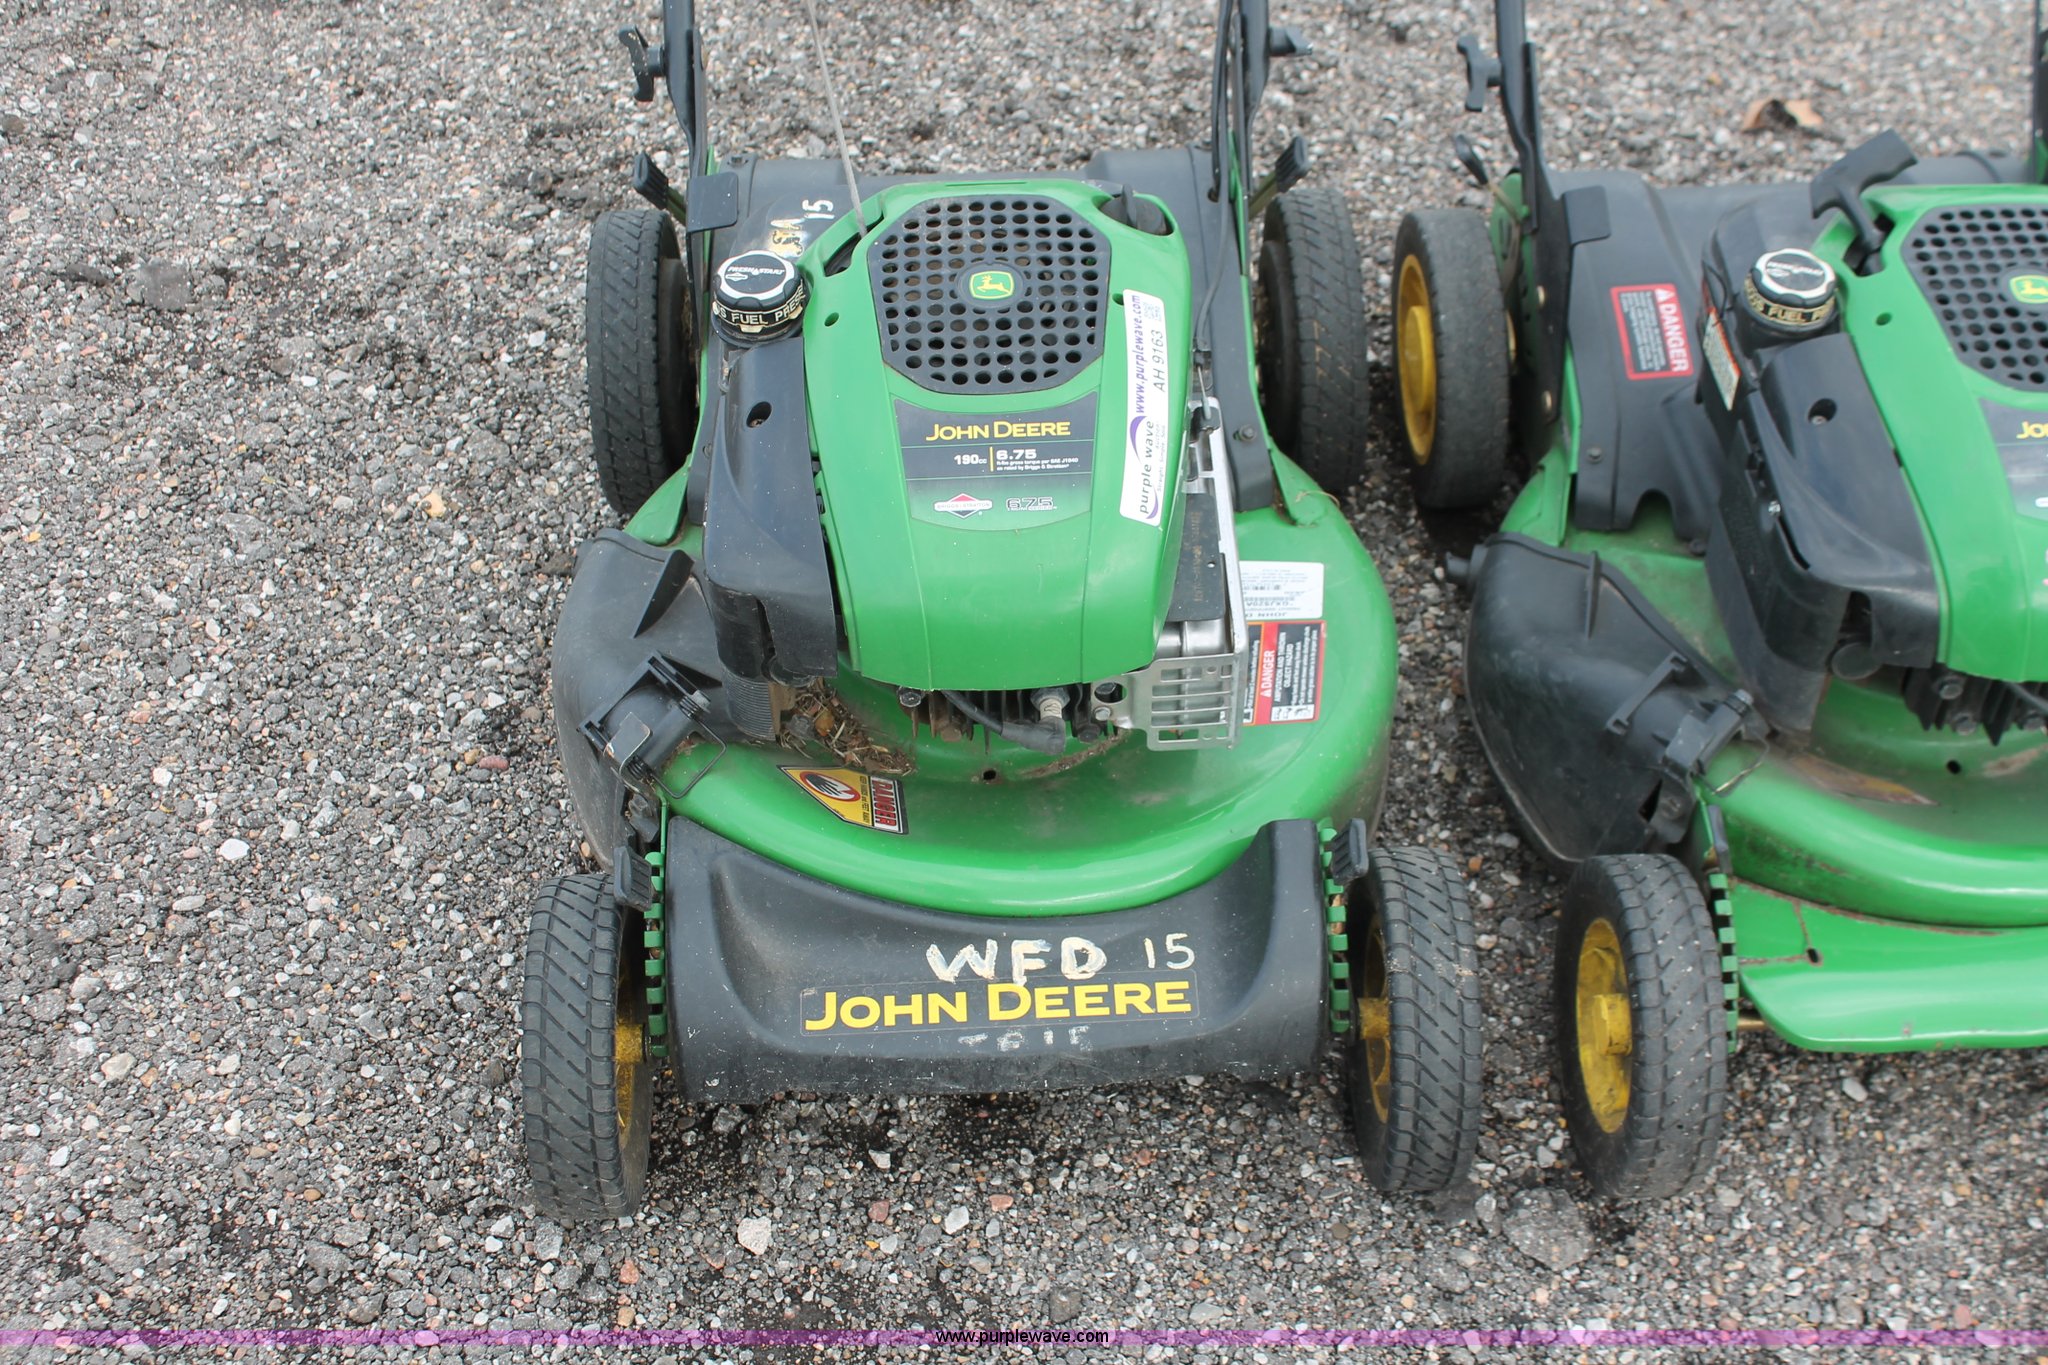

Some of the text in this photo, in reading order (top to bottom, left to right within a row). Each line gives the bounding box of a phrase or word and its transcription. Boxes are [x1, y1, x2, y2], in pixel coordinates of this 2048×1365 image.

[802, 199, 835, 219] 15
[731, 312, 768, 325] FUEL
[1660, 303, 1690, 372] DANGER
[1132, 295, 1148, 413] www.purplewave.com
[1150, 329, 1166, 393] AH 9163
[925, 421, 1071, 441] JOHN DEERE
[996, 449, 1037, 460] 6.75
[1139, 420, 1154, 514] purple wave
[1006, 497, 1054, 510] 675
[1261, 650, 1276, 690] DANGER
[872, 781, 896, 826] DANGER
[925, 932, 1196, 985] WFD 15
[804, 980, 1192, 1031] JOHN DEERE
